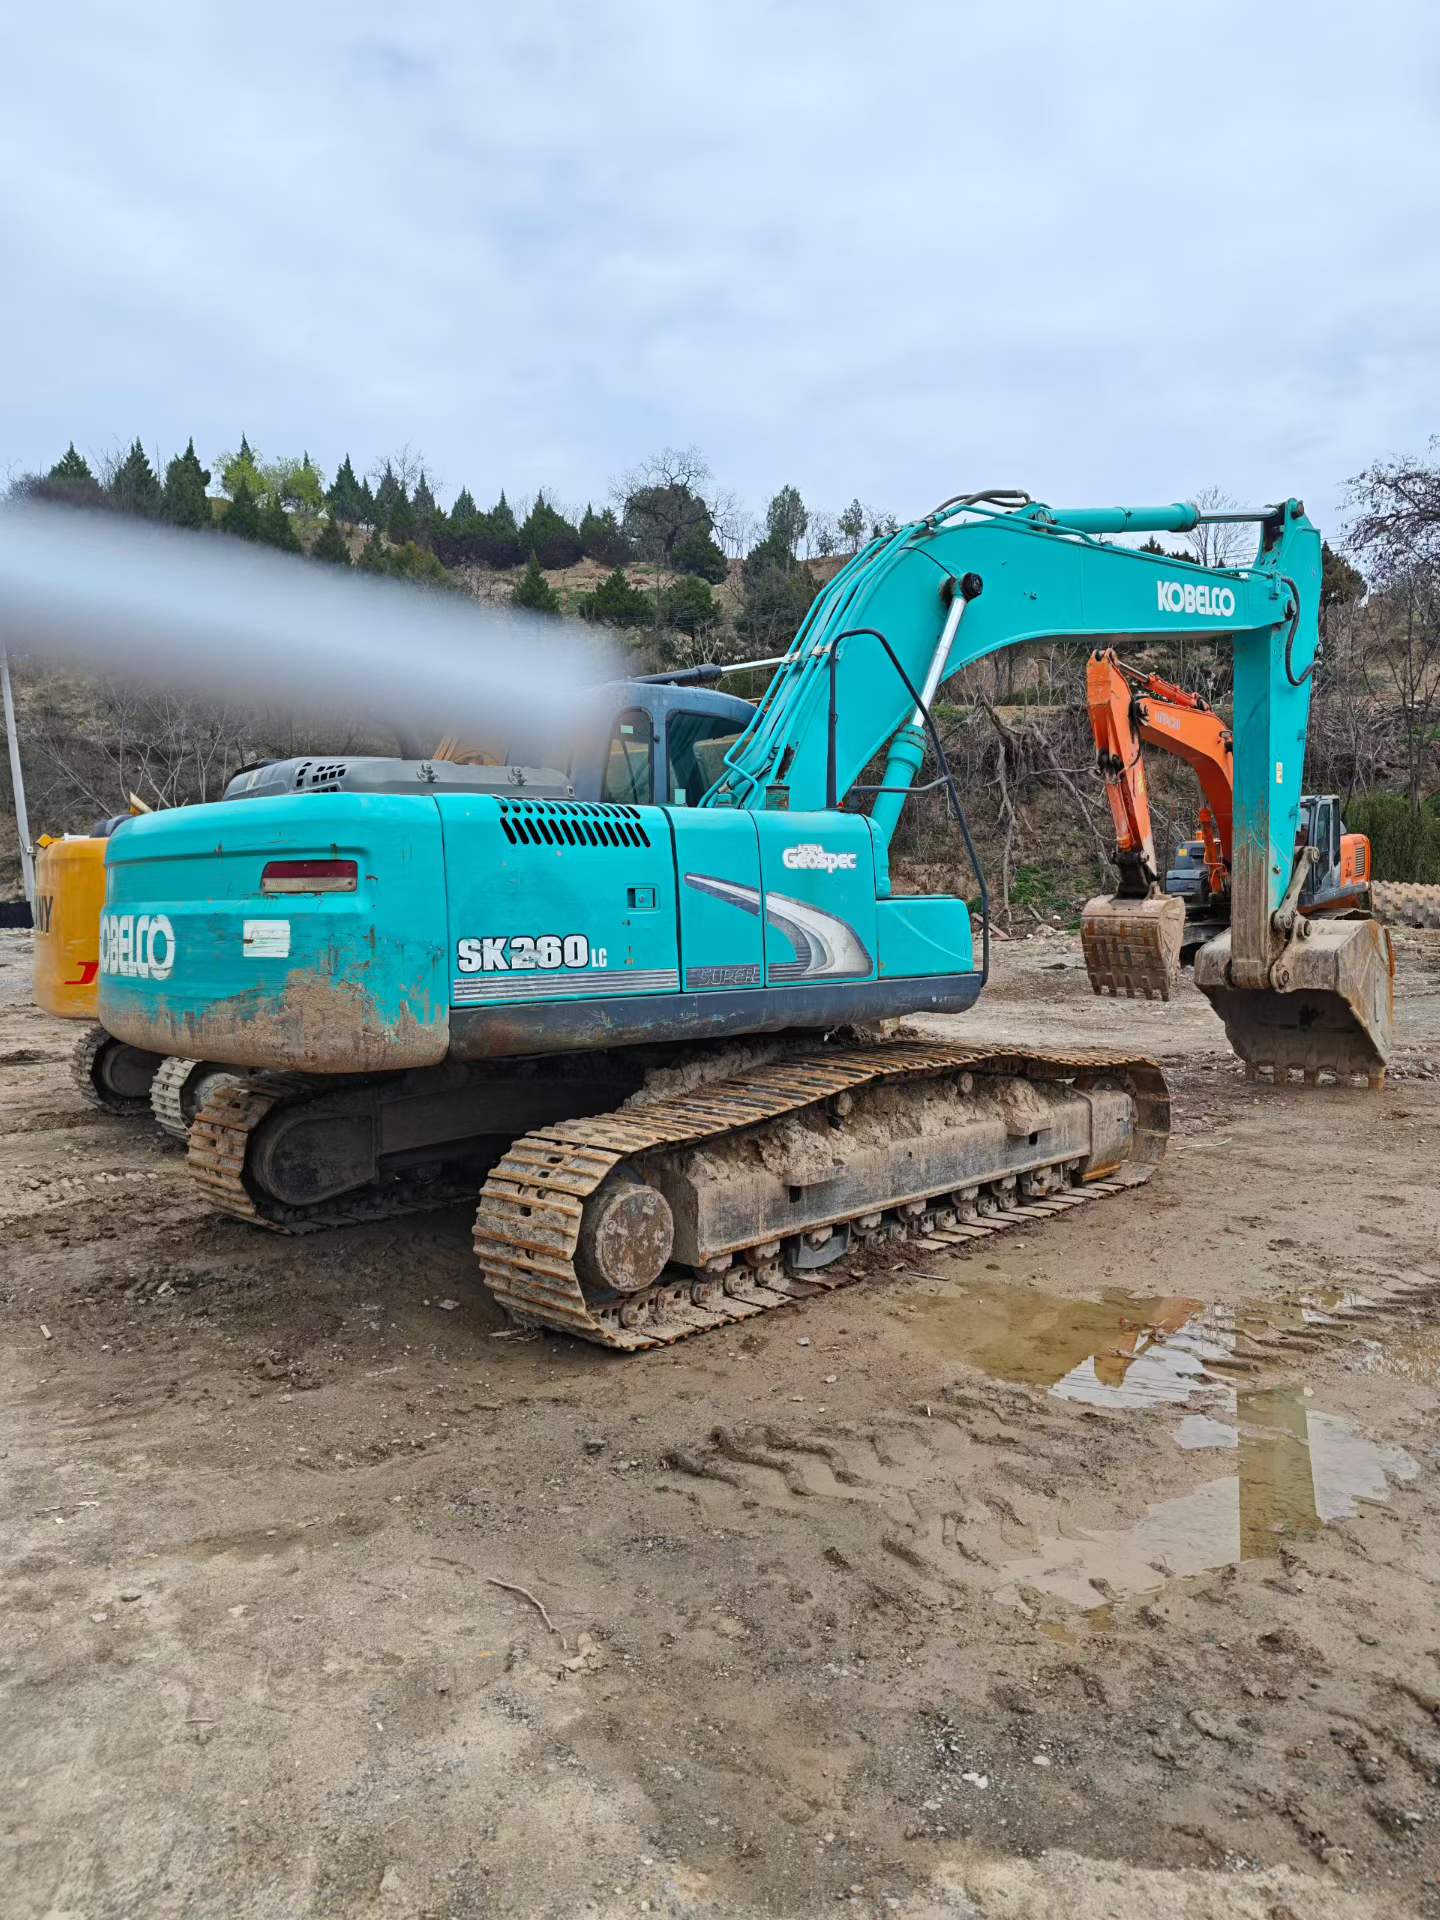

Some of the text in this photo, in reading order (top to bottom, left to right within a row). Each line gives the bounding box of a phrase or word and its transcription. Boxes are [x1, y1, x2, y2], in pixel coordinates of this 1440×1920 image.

[1157, 581, 1235, 617] KOBELCO
[99, 914, 176, 981] OBELCO
[457, 934, 608, 973] SK260 LC
